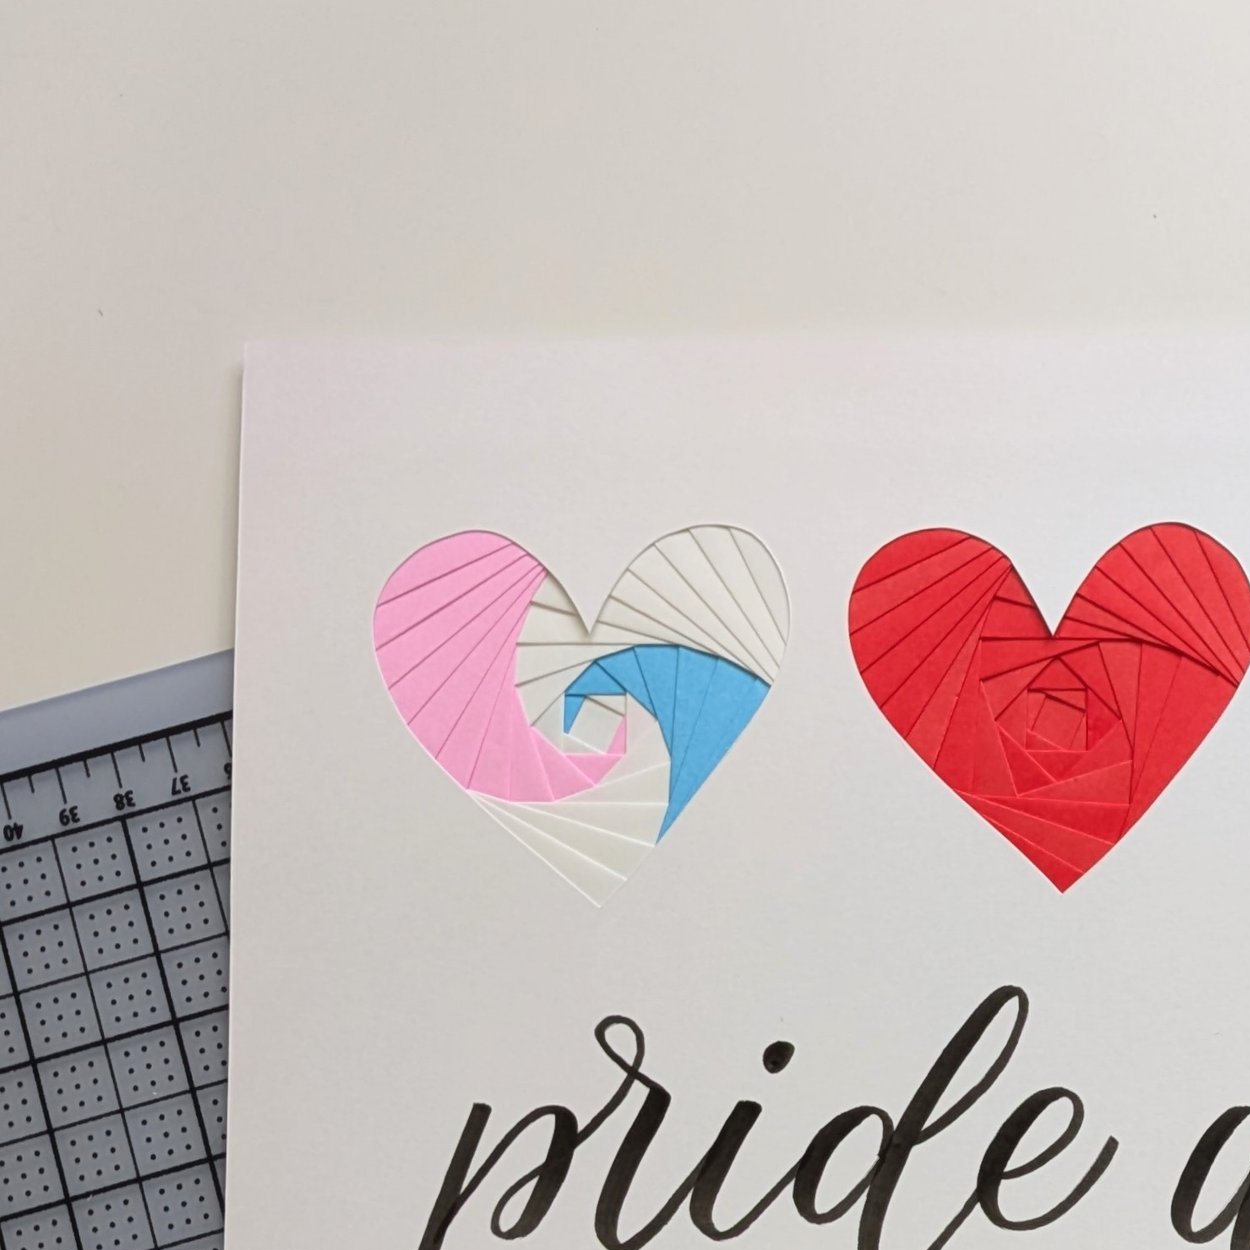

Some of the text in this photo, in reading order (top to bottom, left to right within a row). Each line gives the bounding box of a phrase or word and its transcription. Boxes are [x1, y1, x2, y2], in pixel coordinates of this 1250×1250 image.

[172, 775, 191, 796] 37
[114, 790, 136, 811] 38
[59, 806, 80, 827] 39
[3, 823, 23, 843] 40
